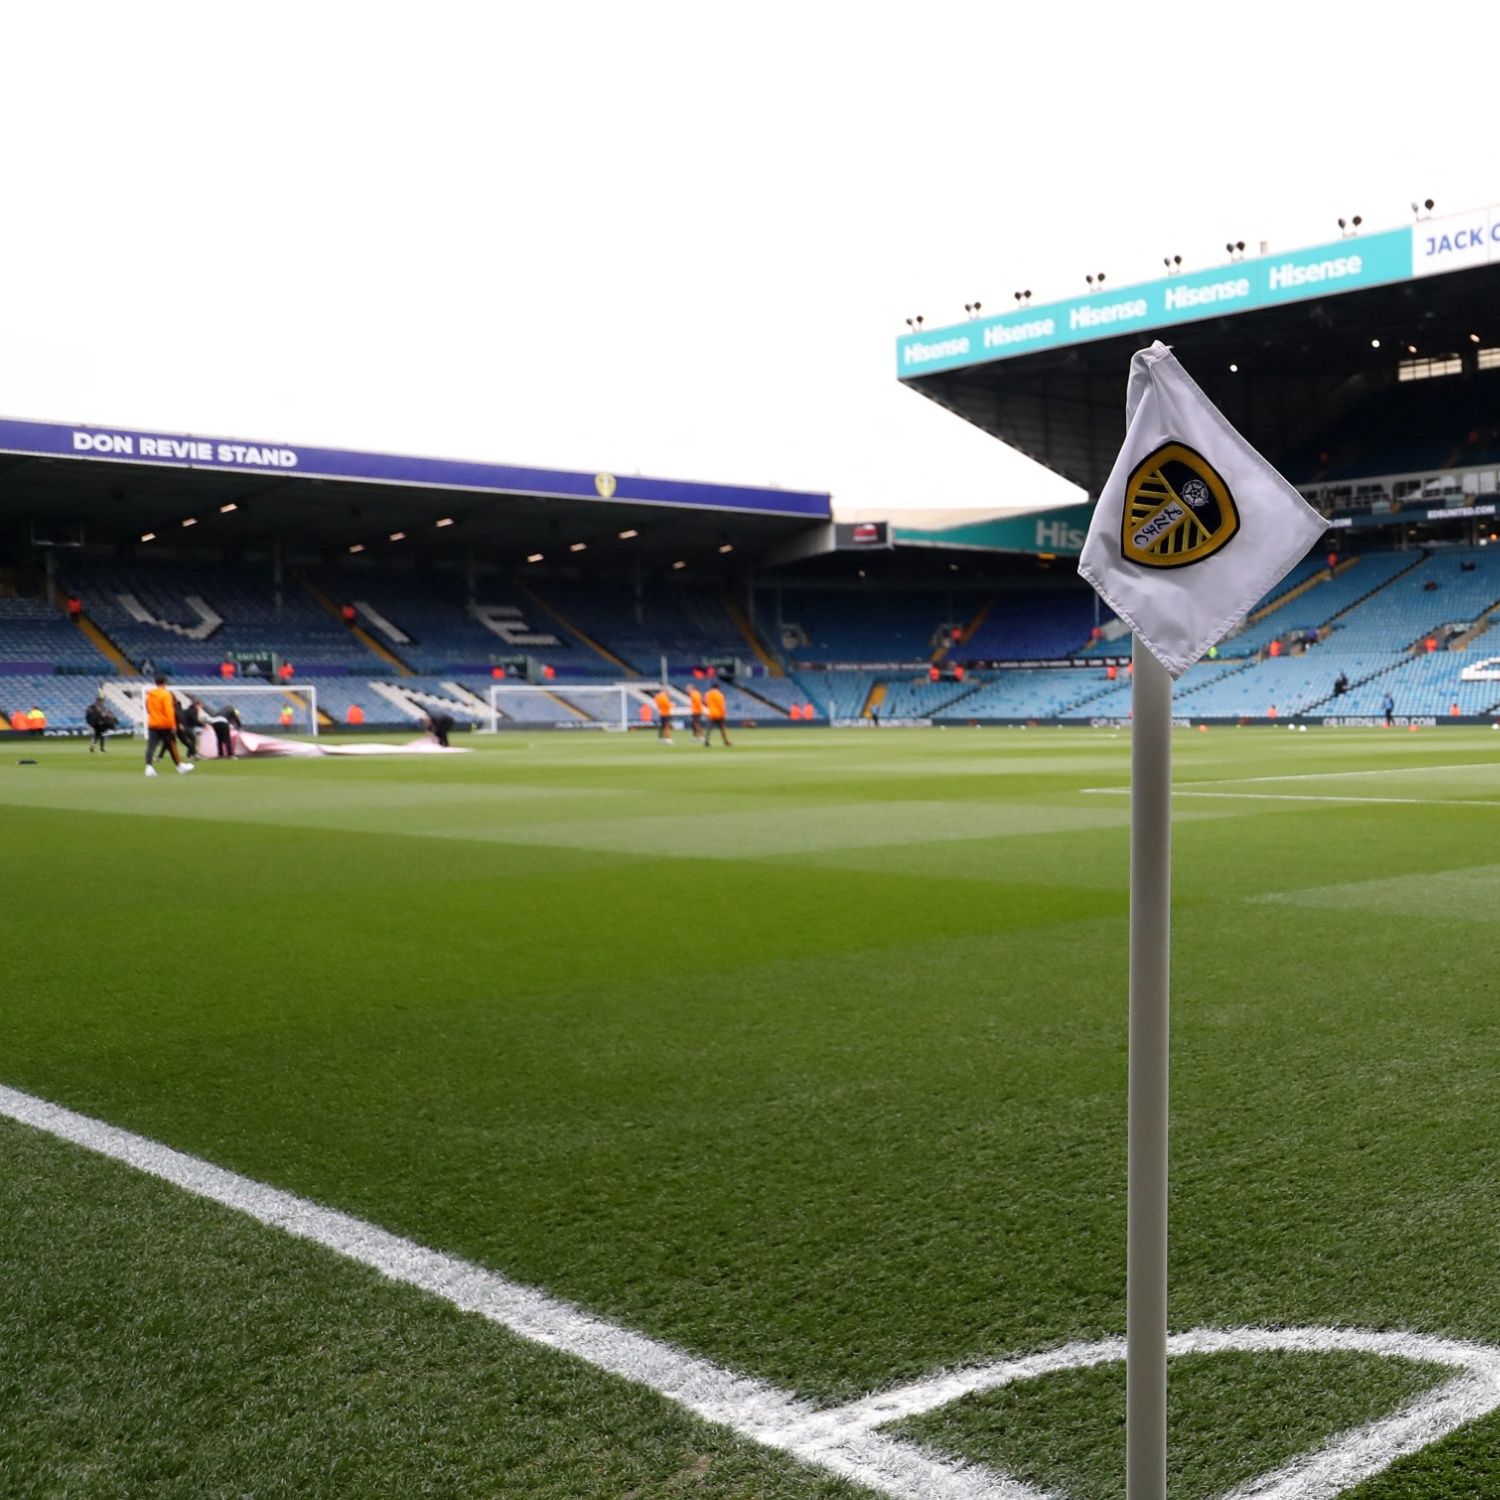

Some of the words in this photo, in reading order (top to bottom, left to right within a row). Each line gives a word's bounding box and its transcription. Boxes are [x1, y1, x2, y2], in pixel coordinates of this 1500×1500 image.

[1425, 229, 1485, 257] JACK
[1270, 256, 1362, 289] Hisense
[1165, 276, 1249, 311] Hisense
[1070, 297, 1146, 330] Hisense
[983, 316, 1054, 348] Hisense
[904, 335, 970, 364] Hisense
[73, 432, 133, 454] DON
[139, 437, 213, 460] REVIE
[218, 444, 297, 467] STAND
[1134, 507, 1183, 544] LUFC
